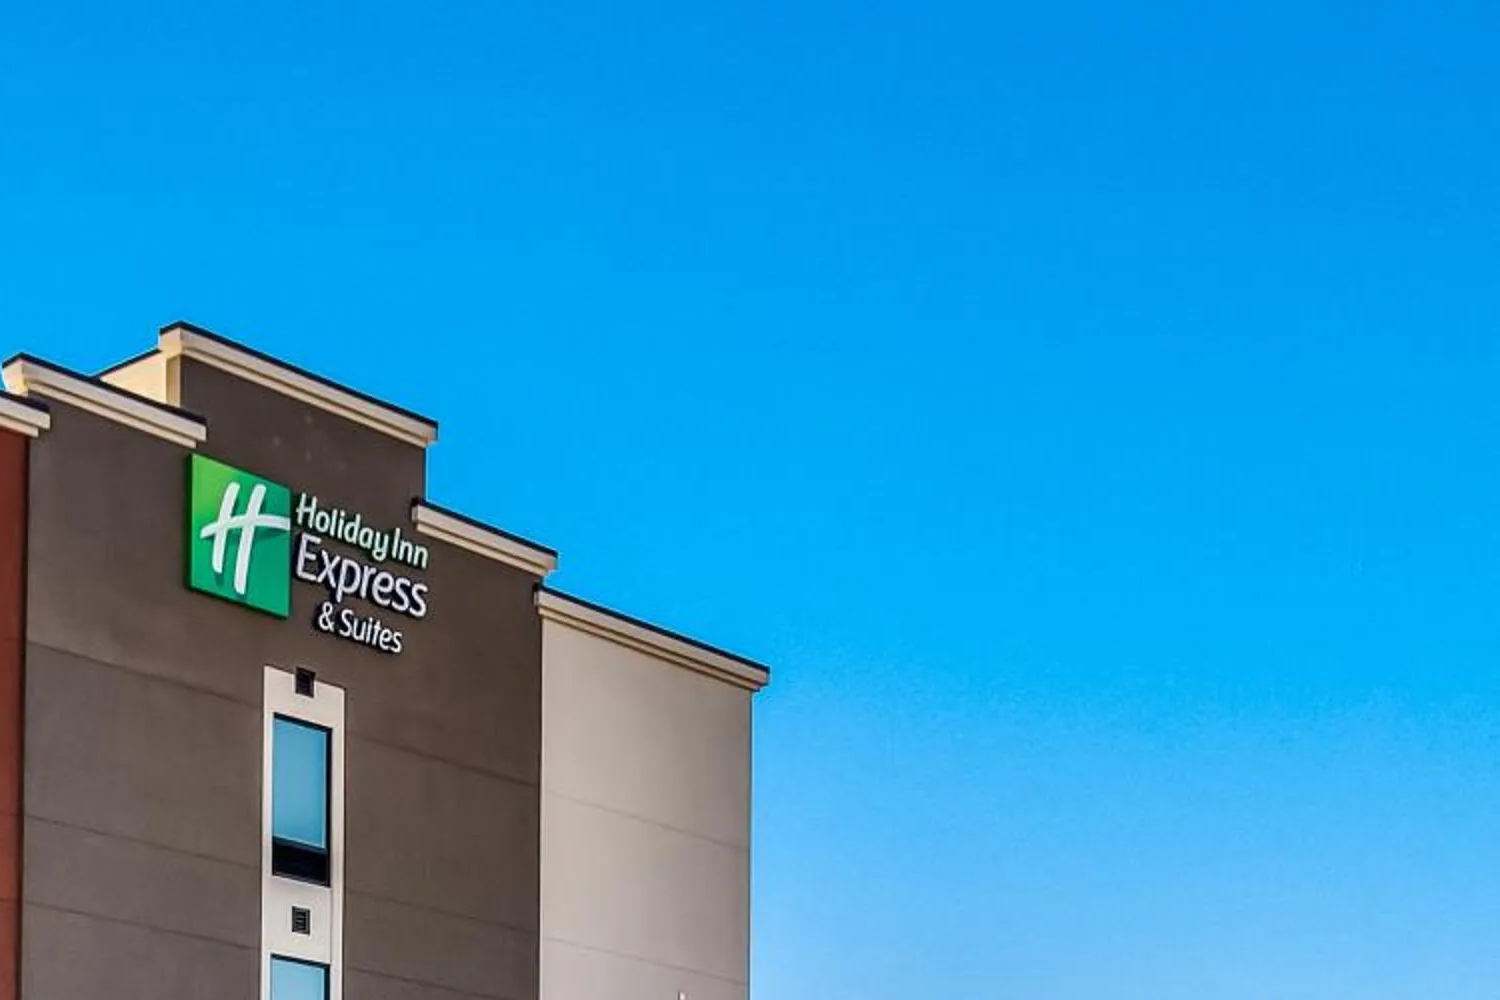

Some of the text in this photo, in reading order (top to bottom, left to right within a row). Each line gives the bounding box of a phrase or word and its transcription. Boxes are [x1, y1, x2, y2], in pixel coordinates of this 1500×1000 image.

[296, 492, 429, 569] Holiday Inn
[295, 533, 429, 618] Express
[317, 601, 402, 653] & Suites
